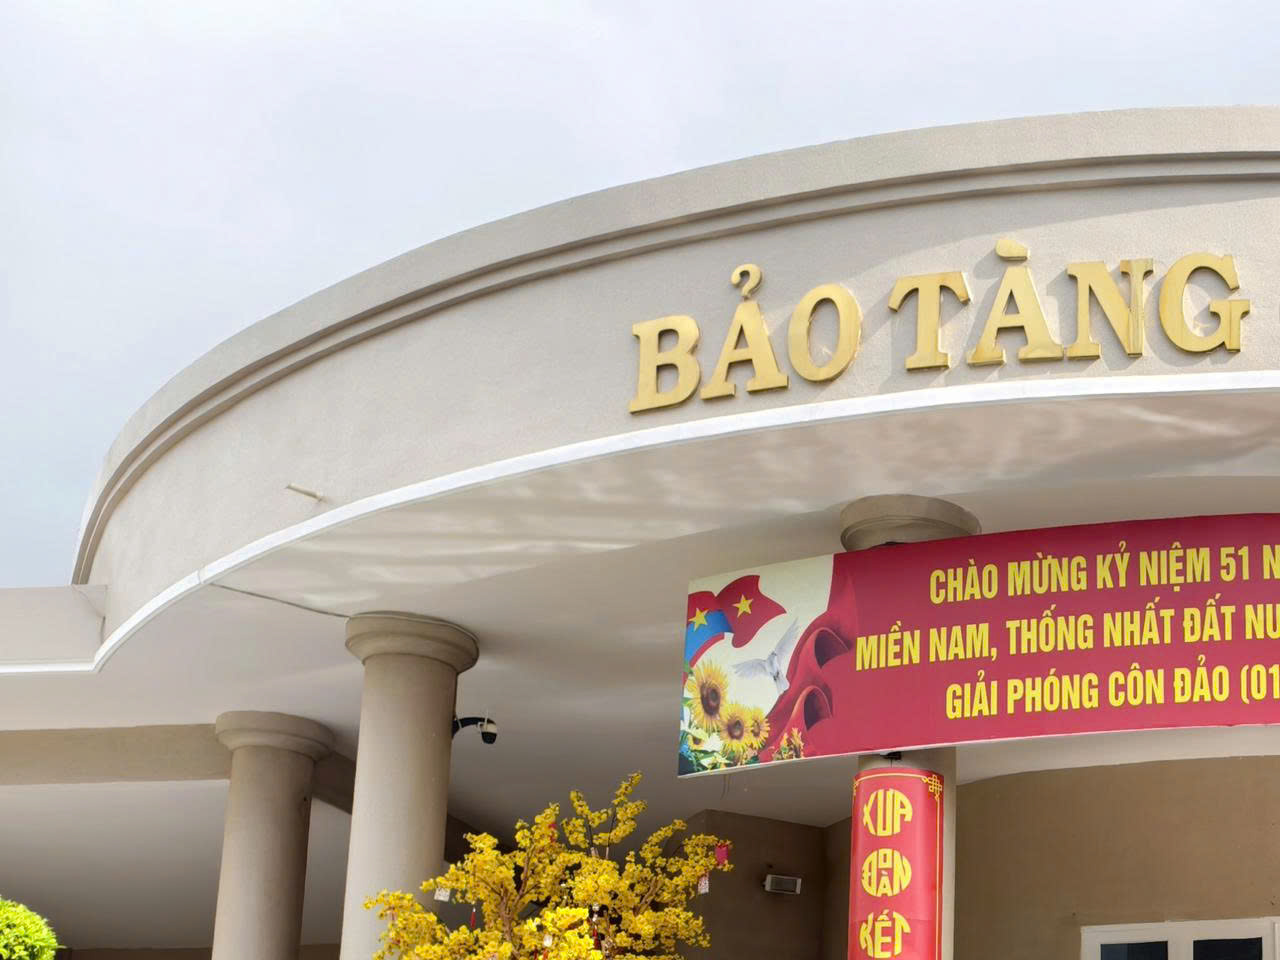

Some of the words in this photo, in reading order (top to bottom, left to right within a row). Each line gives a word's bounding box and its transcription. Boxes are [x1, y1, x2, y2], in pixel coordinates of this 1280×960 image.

[629, 263, 863, 414] BẢO
[888, 238, 1251, 372] TÀNG
[929, 557, 998, 605] CHÀO
[1007, 552, 1088, 596] MỪNG
[1096, 540, 1131, 590] KỶ
[1139, 540, 1211, 593] NIỆM
[1219, 545, 1250, 582] 51
[855, 620, 921, 671] MIỀN
[929, 622, 998, 662] NAM,
[1006, 604, 1095, 656] THỐNG
[1103, 596, 1176, 649] NHẤT
[1183, 592, 1237, 644] ĐẤT
[945, 669, 998, 720] GIẢI
[1007, 668, 1099, 714] PHÓNG
[1108, 662, 1165, 707] CÔN
[1173, 654, 1230, 703] ĐẢO
[858, 909, 912, 960] KẾT
